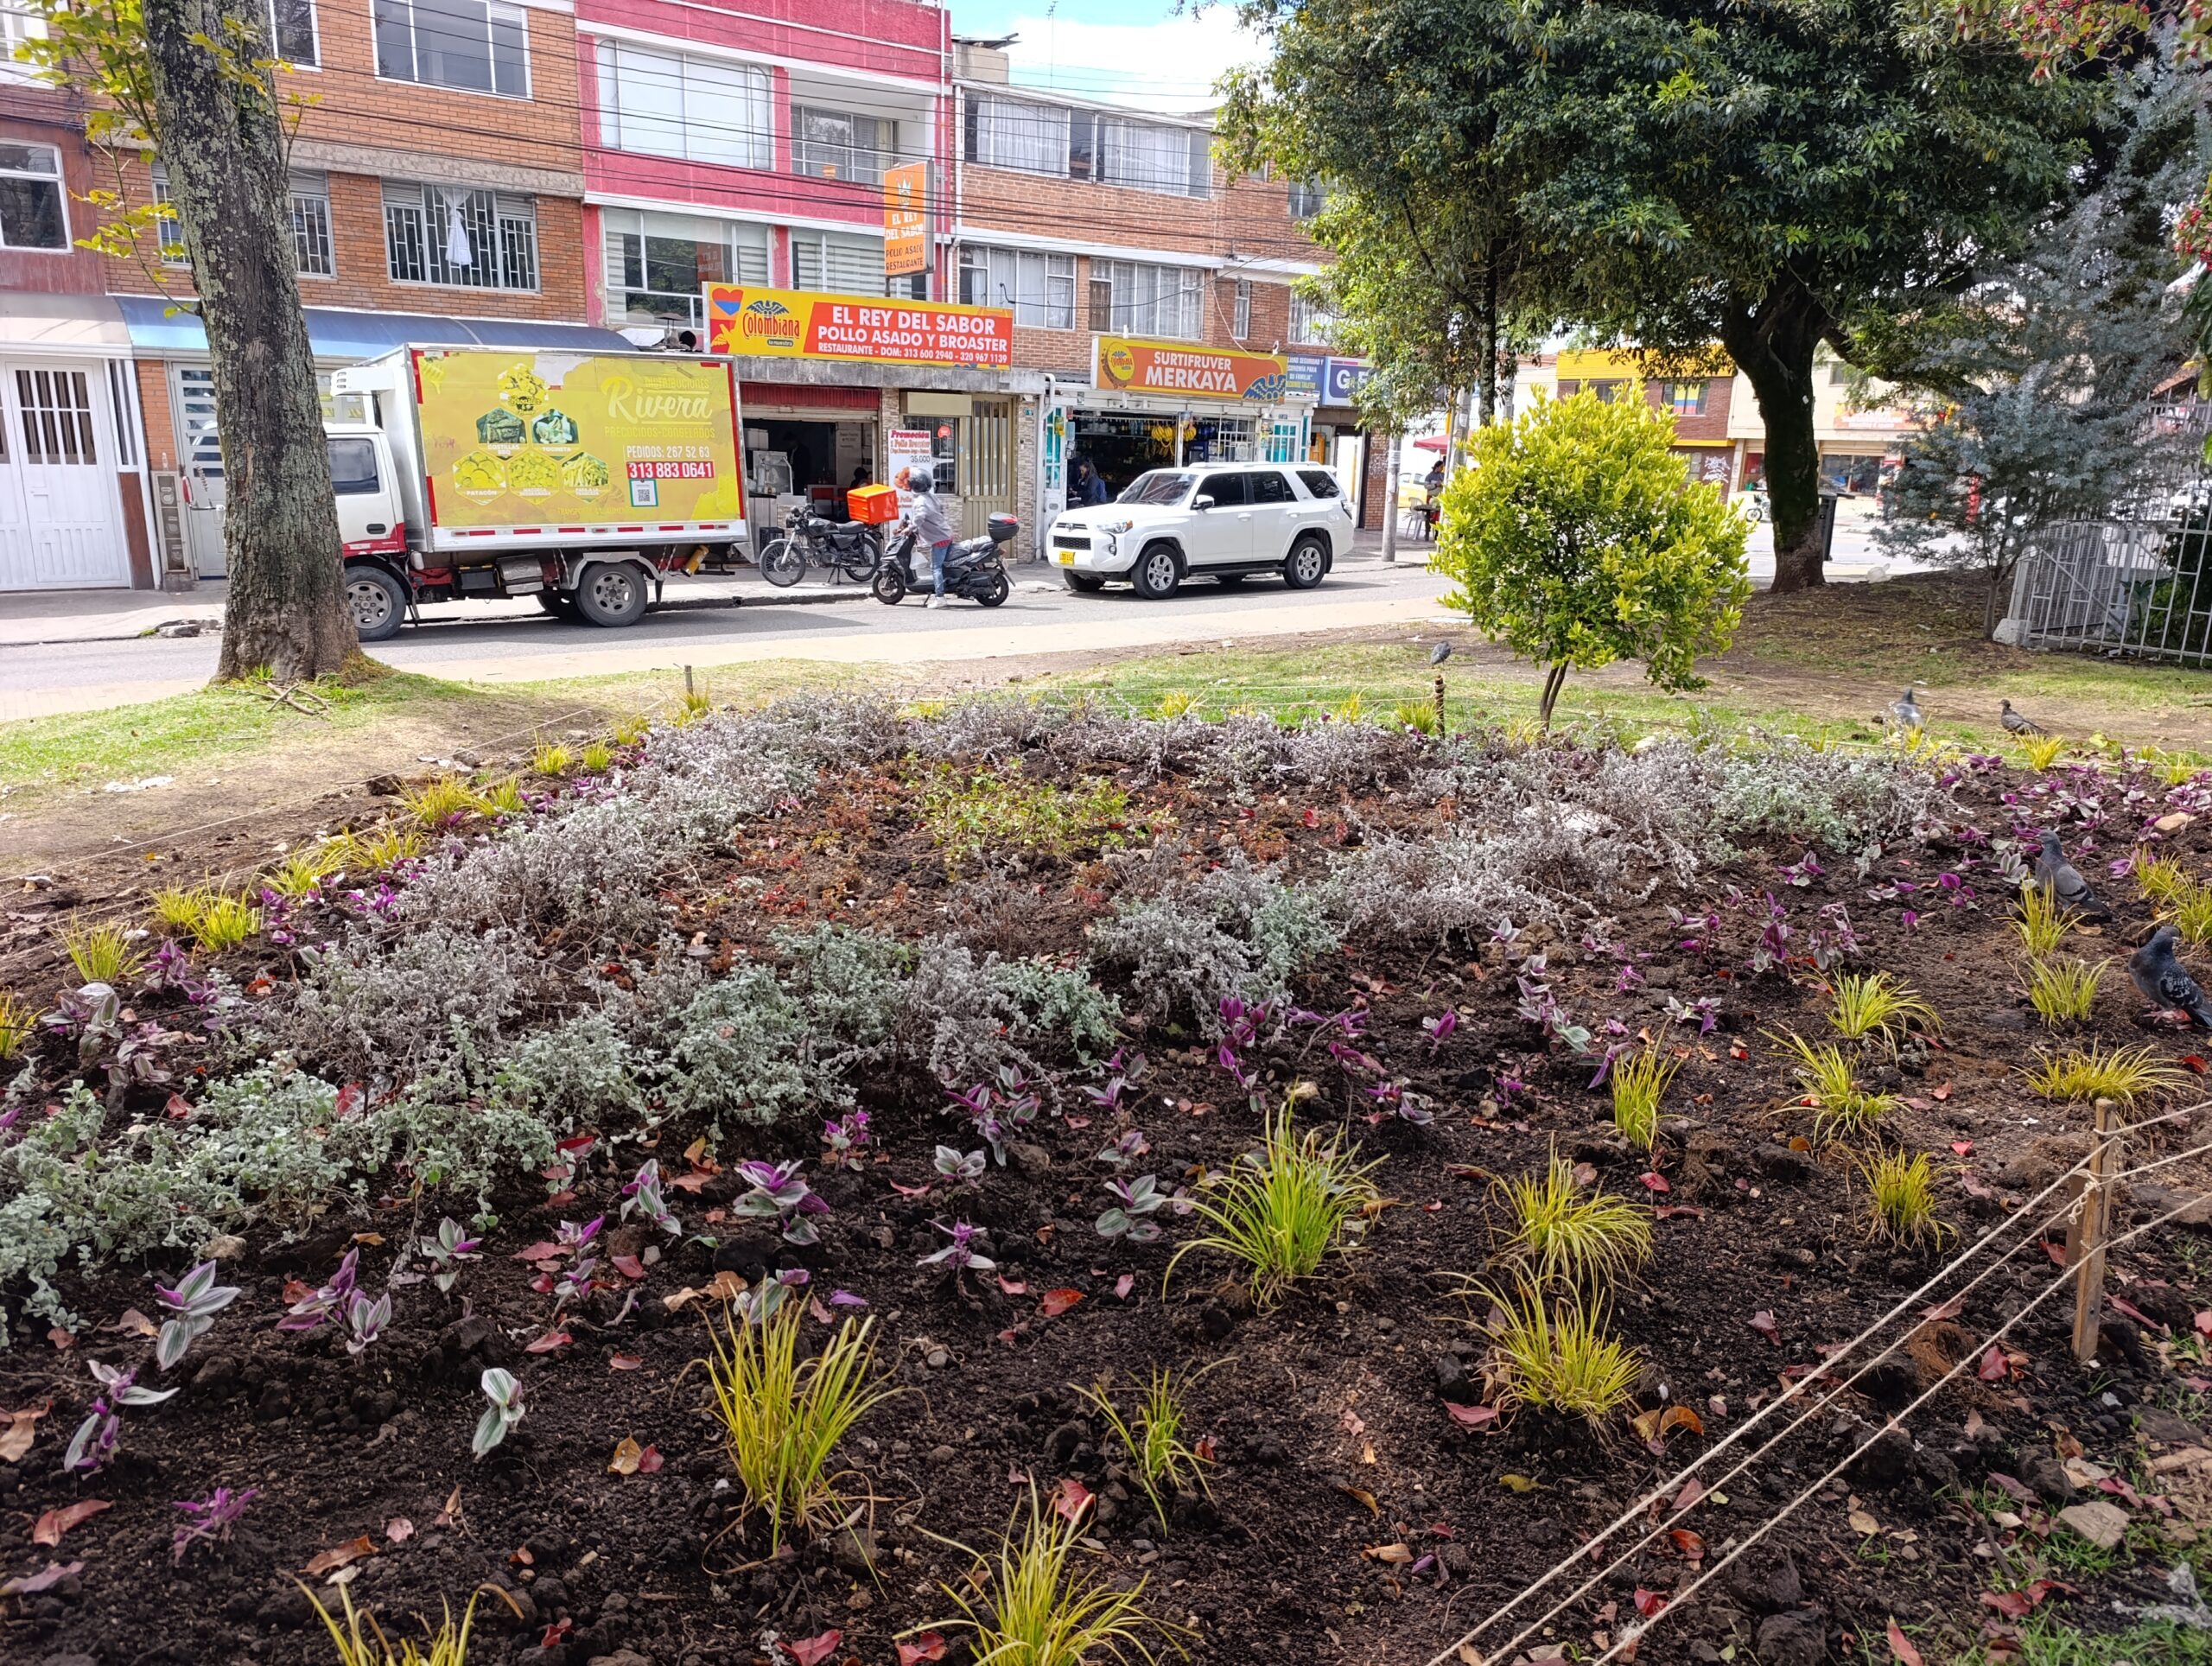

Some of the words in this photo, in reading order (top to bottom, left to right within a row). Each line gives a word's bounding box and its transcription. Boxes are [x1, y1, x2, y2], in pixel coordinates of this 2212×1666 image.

[892, 213, 901, 226] EL
[904, 212, 917, 223] REY
[886, 228, 899, 240] DEL
[901, 223, 924, 238] SABOR
[886, 248, 902, 258] POLLO
[906, 244, 924, 255] ASADO
[886, 258, 924, 270] RESTAURANTE
[743, 313, 800, 339] Colombiana
[833, 306, 853, 325] EL
[859, 308, 893, 327] REY
[898, 312, 931, 330] DEL
[936, 315, 995, 335] SABOR
[818, 326, 867, 341] POLLO
[871, 330, 922, 346] ASADO
[925, 334, 936, 347] Y
[939, 335, 1007, 352] BROASTER
[818, 343, 873, 355] RESTAURANTE
[880, 347, 902, 357] DOM:
[904, 348, 918, 359] 313
[919, 349, 933, 359] 600
[936, 350, 953, 359] 2940
[960, 352, 974, 361] 320
[976, 353, 988, 363] 967
[990, 354, 1007, 364] 1139
[1154, 351, 1231, 371] SURTIFRUVER
[645, 377, 709, 389] DISTRIBUCIONES
[1145, 366, 1237, 391] MERKAYA
[600, 376, 713, 424] Rivera
[626, 445, 664, 458] PEDIDOS:
[666, 445, 683, 458] 267
[685, 446, 696, 458] 52
[698, 446, 709, 458] 63
[629, 462, 653, 478] 313
[656, 462, 679, 478] 883
[682, 462, 712, 478] 0641
